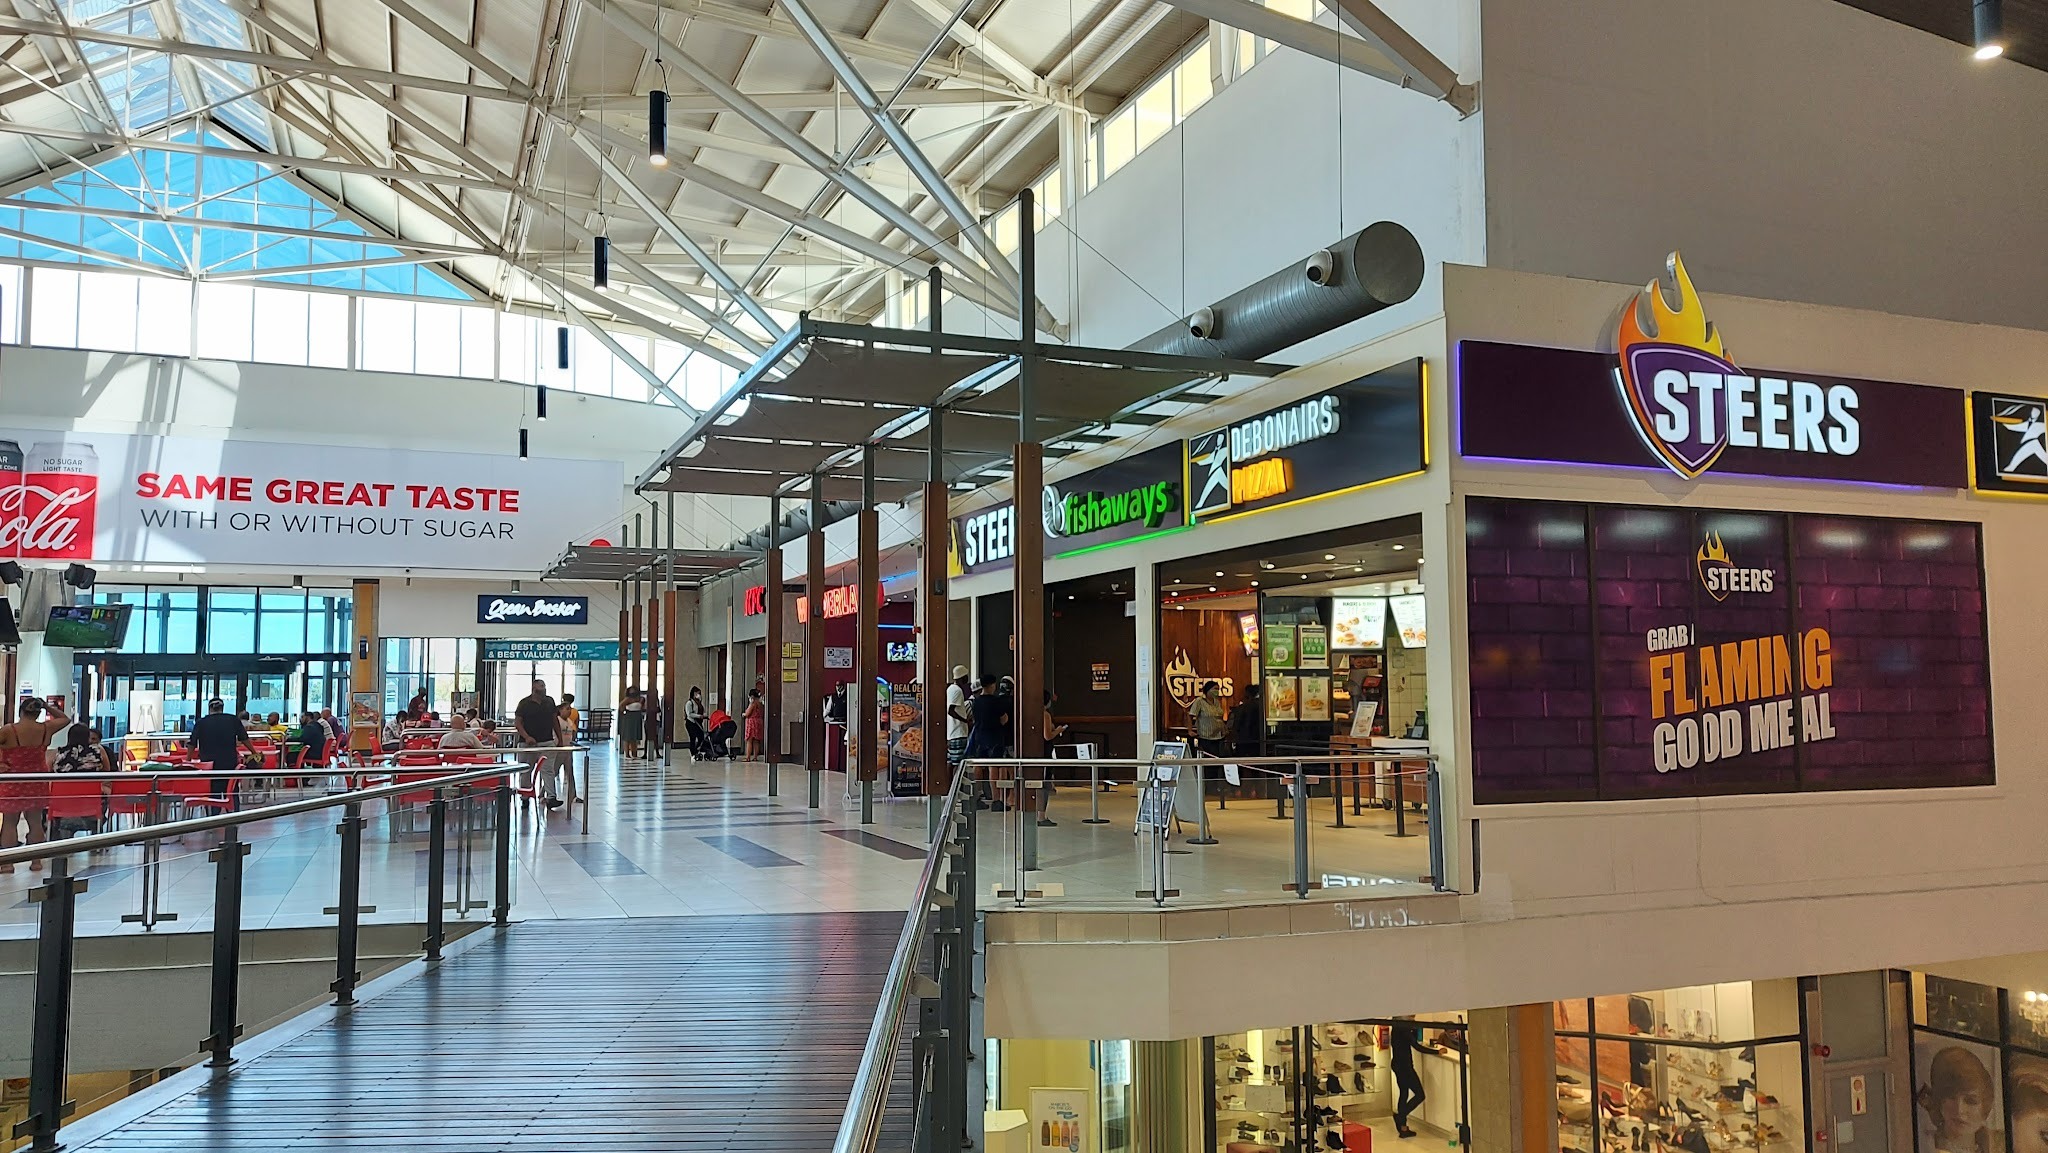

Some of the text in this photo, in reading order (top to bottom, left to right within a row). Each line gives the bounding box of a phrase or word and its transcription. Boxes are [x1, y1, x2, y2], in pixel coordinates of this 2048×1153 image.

[1231, 394, 1335, 463] DEBONAIRS
[1653, 369, 1860, 456] STEERS
[136, 472, 520, 513] SAME GREAT TASTE
[1232, 458, 1289, 505] PIZZA
[140, 508, 515, 540] WITH OR WITHOUT SUGAR
[1065, 480, 1169, 537] fishaways
[1707, 567, 1774, 593] STEERS
[485, 598, 582, 621] Ocean Basket
[744, 585, 766, 617] KFC
[510, 643, 578, 651] BEST SEAFOOD
[1647, 624, 1689, 652] GRAB
[488, 651, 577, 659] & BEST VALUE AT N1
[893, 683, 911, 693] REAL
[1649, 627, 1833, 720] FLAMING
[1653, 692, 1836, 774] GOOD MEAL
